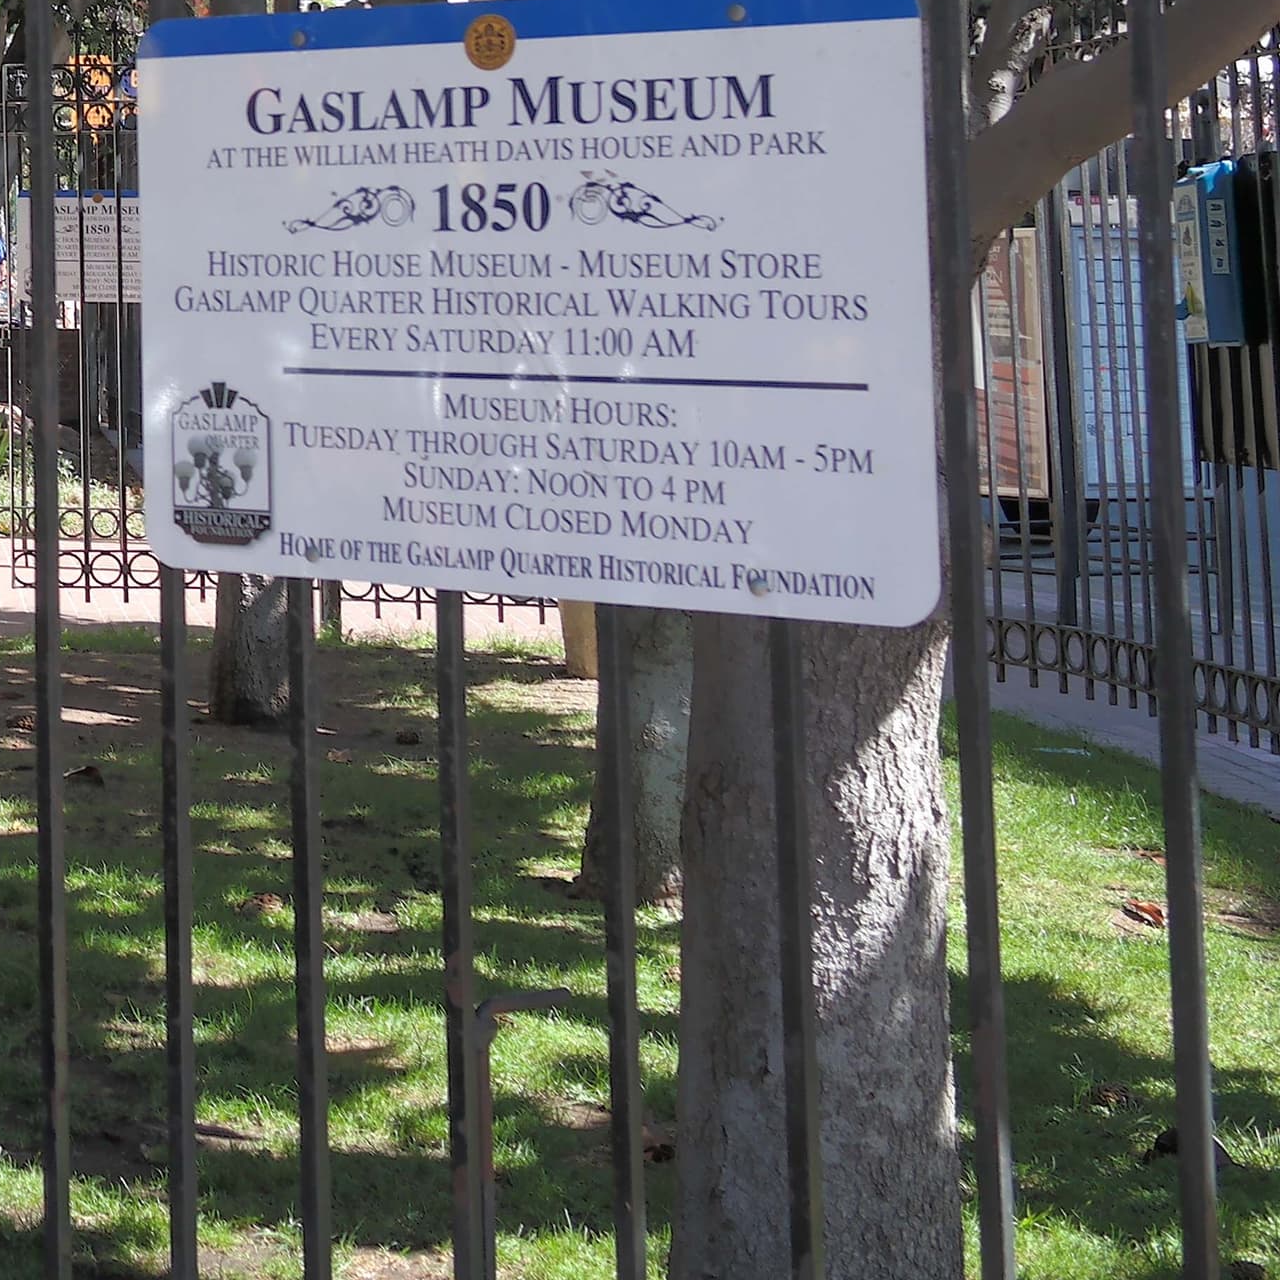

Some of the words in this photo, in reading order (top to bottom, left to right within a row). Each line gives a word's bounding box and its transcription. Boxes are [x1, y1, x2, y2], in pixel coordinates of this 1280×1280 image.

[246, 86, 490, 135] GASLAMP
[507, 73, 776, 126] MUSEUM
[206, 148, 237, 170] AT
[242, 146, 288, 168] THE
[295, 143, 396, 166] WILLIAM
[404, 140, 488, 164] HEATH
[496, 137, 573, 161] DAVIS
[580, 135, 673, 160] HOUSE
[681, 133, 741, 157] AND
[749, 131, 827, 156] PARK
[432, 183, 550, 232] 1850
[85, 224, 110, 235] 1850
[207, 250, 325, 277] HISTORIC
[331, 250, 422, 277] HOUSE
[430, 250, 552, 278] MUSEUM
[578, 249, 711, 278] MUSEUM
[720, 249, 823, 279] STORE
[174, 285, 291, 313] GASLAMP
[298, 286, 425, 316] QUARTER
[432, 287, 599, 317] HISTORICAL
[607, 288, 750, 319] WALKING
[759, 290, 869, 321] TOURS
[310, 322, 398, 352] EVERY
[406, 324, 554, 355] SATURDAY
[565, 327, 633, 357] 11:00
[642, 328, 697, 359] AM
[178, 413, 258, 433] GASLAMP
[444, 393, 562, 423] MUSEUM
[571, 397, 677, 428] HOURS:
[205, 434, 259, 450] QUARTER
[284, 422, 399, 454] TUESDAY
[406, 429, 538, 458] THROUGH
[546, 433, 699, 467] SATURDAY
[711, 440, 786, 470] 10AM
[814, 444, 874, 474] 5PM
[404, 462, 519, 493] SUNDAY:
[528, 469, 607, 499] NOON
[615, 475, 653, 501] TO
[661, 476, 676, 503] 4
[685, 479, 726, 505] PM
[183, 510, 266, 529] HISTORICAL
[189, 523, 256, 538] FOUNDATION
[383, 496, 496, 528] MUSEUM
[505, 503, 612, 536] CLOSED
[621, 510, 752, 544] MONDAY
[280, 532, 335, 559] HOME
[340, 539, 364, 561] OF
[367, 541, 402, 564] THE
[407, 541, 494, 571] GASLAMP
[500, 547, 592, 578] QUARTER
[599, 554, 725, 589] HISTORICAL
[730, 563, 876, 600] FOUNDATION
